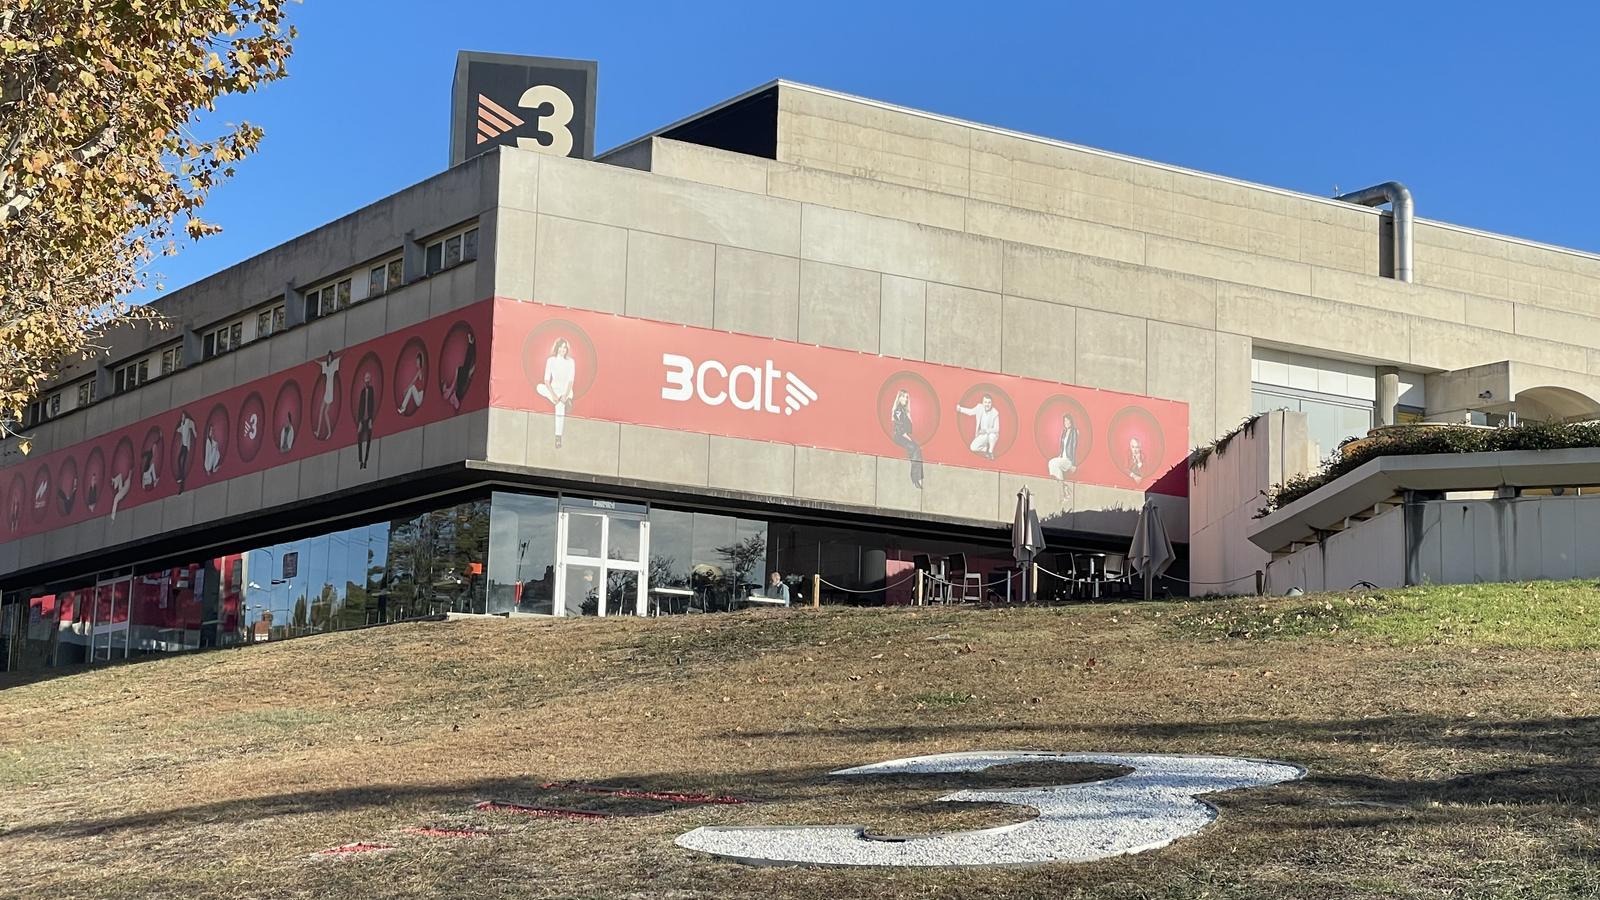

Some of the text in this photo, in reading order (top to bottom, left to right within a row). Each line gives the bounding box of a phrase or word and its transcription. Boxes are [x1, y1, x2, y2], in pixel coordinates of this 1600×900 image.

[517, 85, 574, 157] 3
[662, 353, 781, 414] 3cat
[249, 413, 258, 440] 3
[674, 750, 1308, 867] 3
